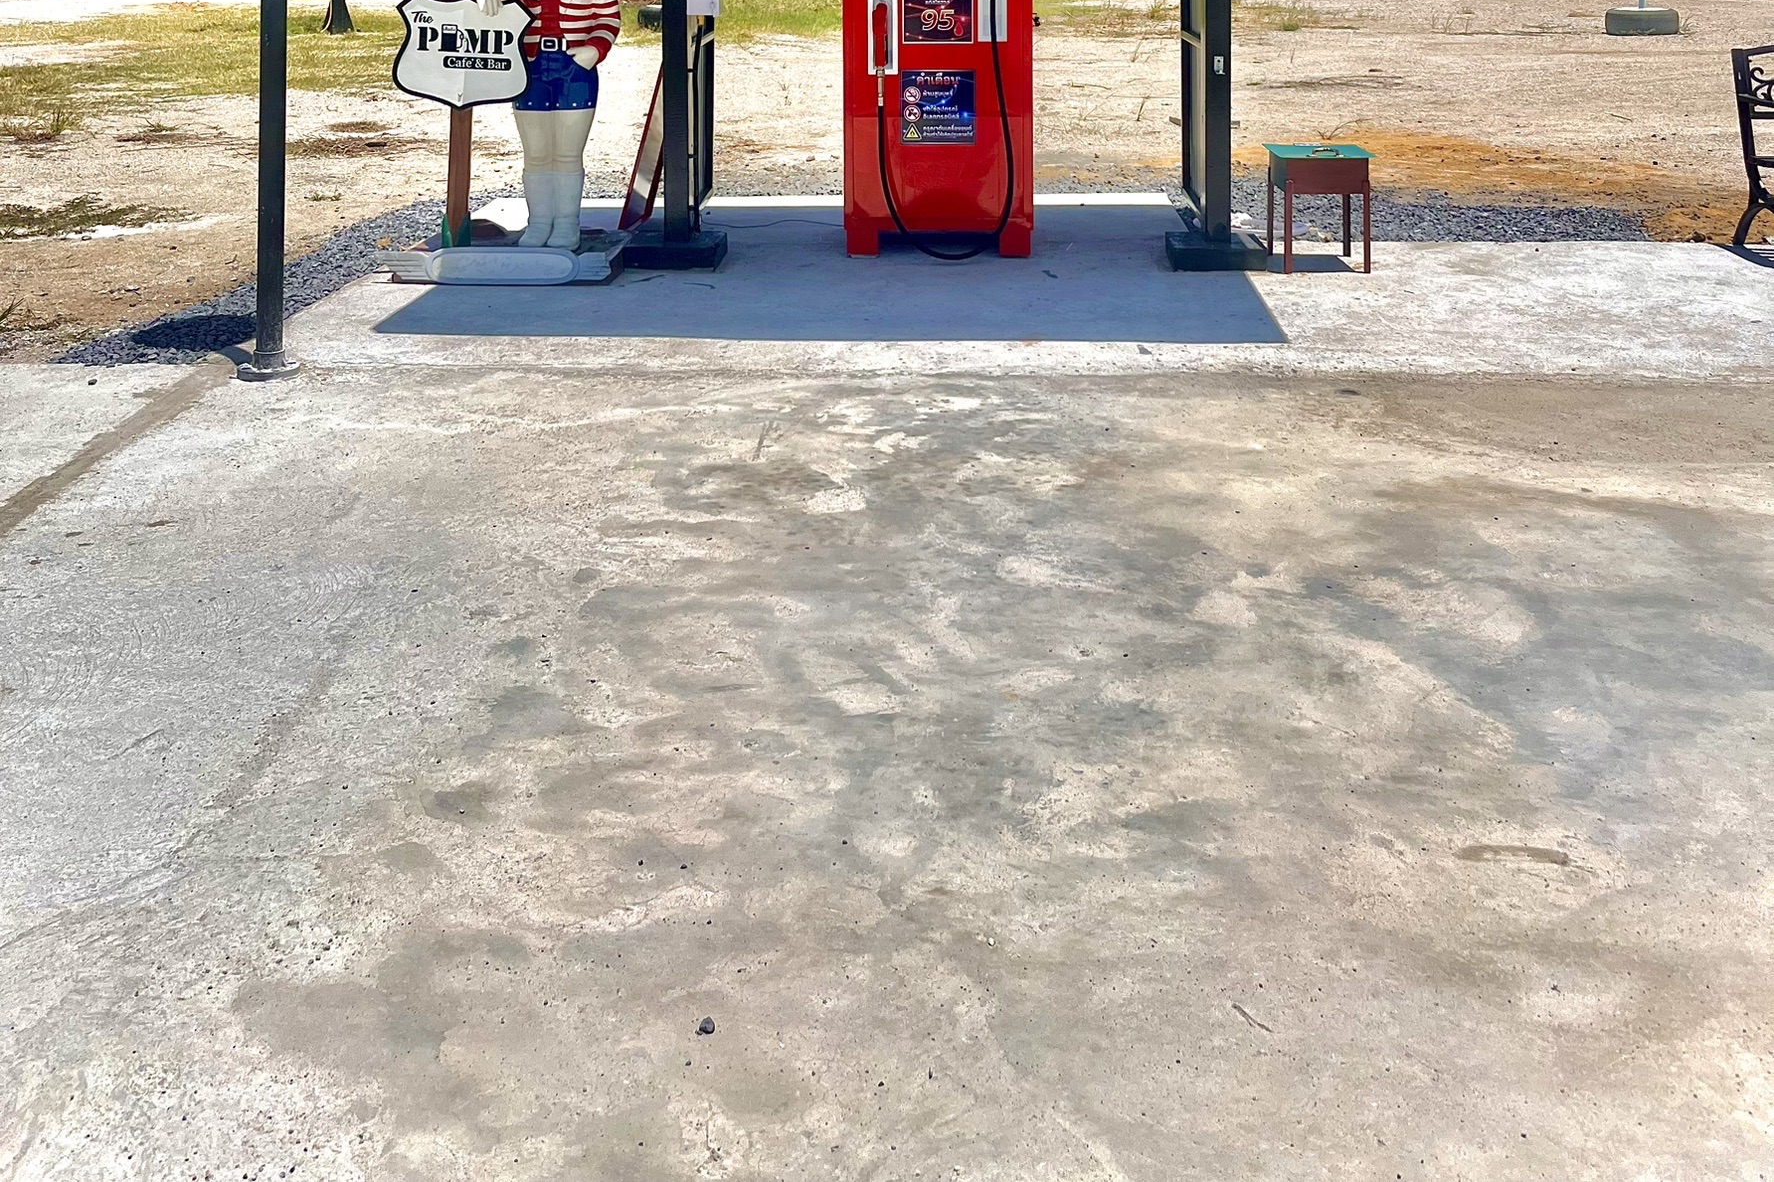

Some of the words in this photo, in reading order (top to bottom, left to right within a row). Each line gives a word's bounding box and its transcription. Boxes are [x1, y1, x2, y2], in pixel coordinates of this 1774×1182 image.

[411, 11, 434, 24] The
[920, 8, 955, 31] 95
[475, 58, 484, 69] &
[487, 58, 507, 70] Bar
